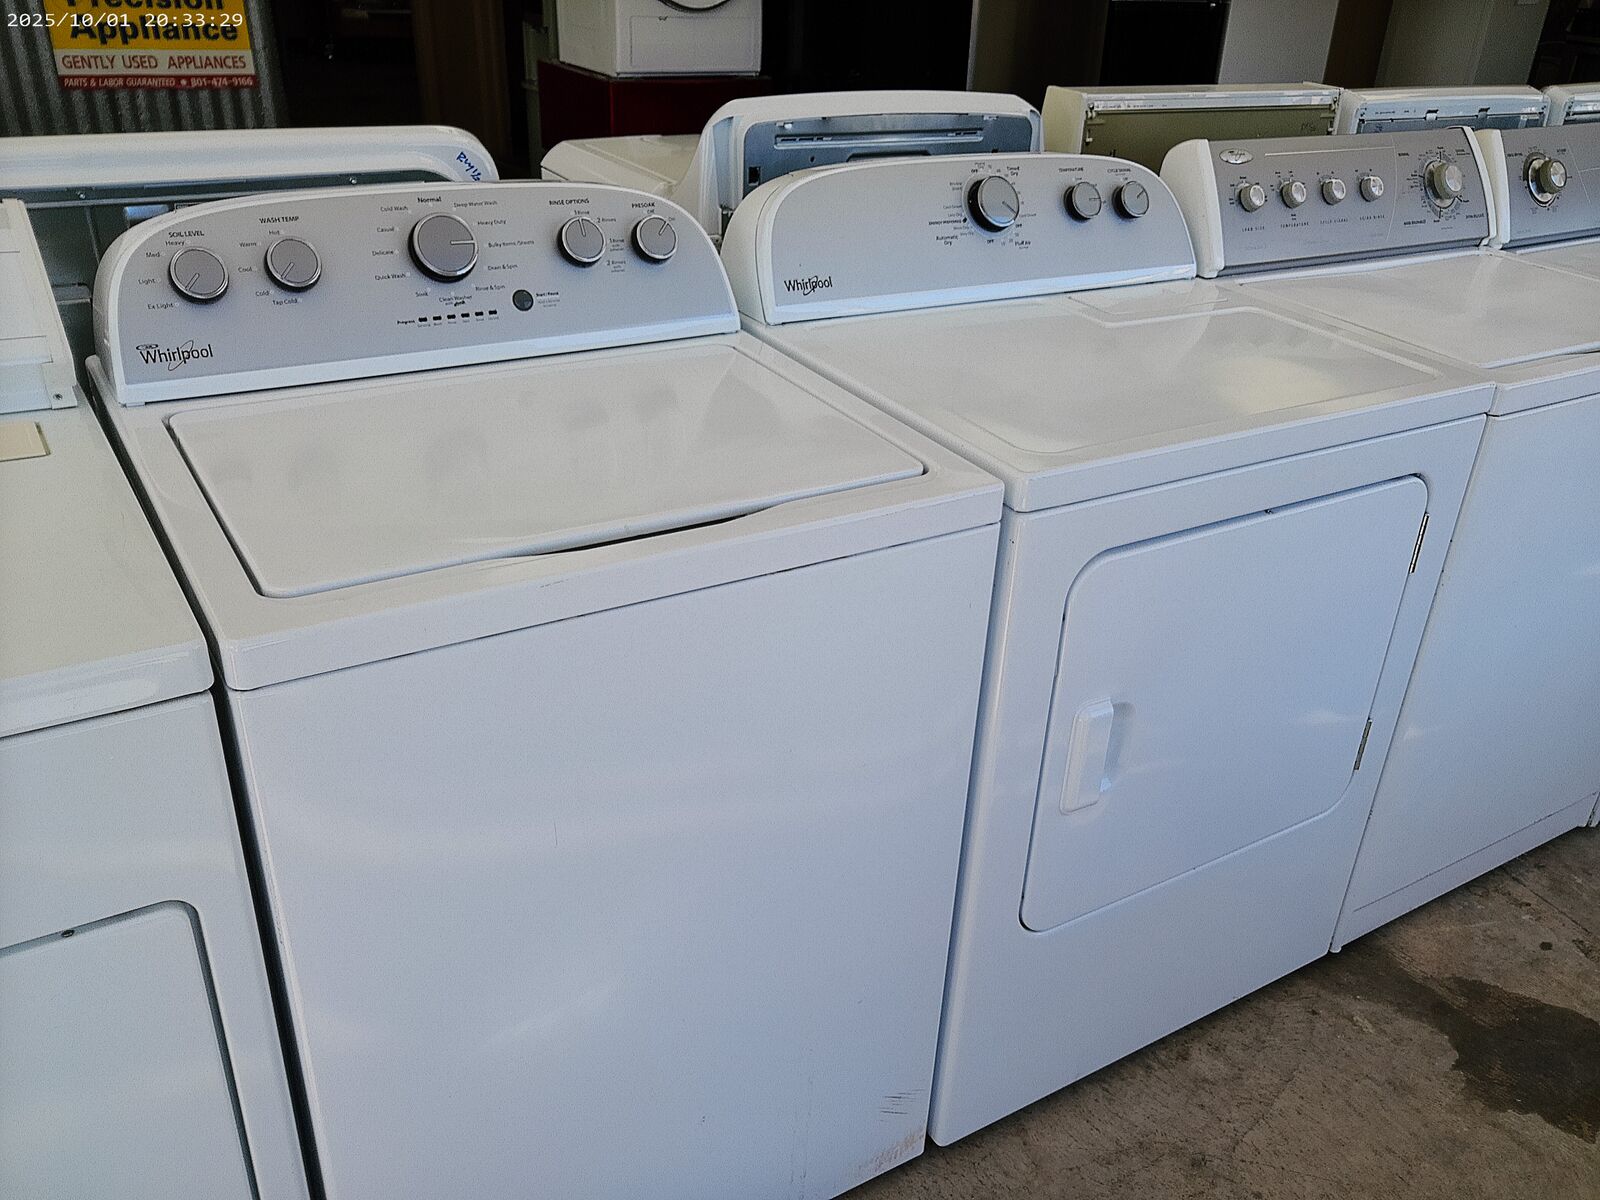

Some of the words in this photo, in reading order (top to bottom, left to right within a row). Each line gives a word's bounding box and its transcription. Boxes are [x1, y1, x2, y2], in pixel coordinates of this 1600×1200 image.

[61, 54, 116, 70] GENTLY
[121, 55, 158, 69] USED
[167, 55, 247, 70] APPLIANCES
[64, 77, 88, 88] PARTS
[98, 77, 124, 88] LABOR
[783, 275, 833, 293] Whirlpool
[139, 343, 214, 364] Whirlpool
